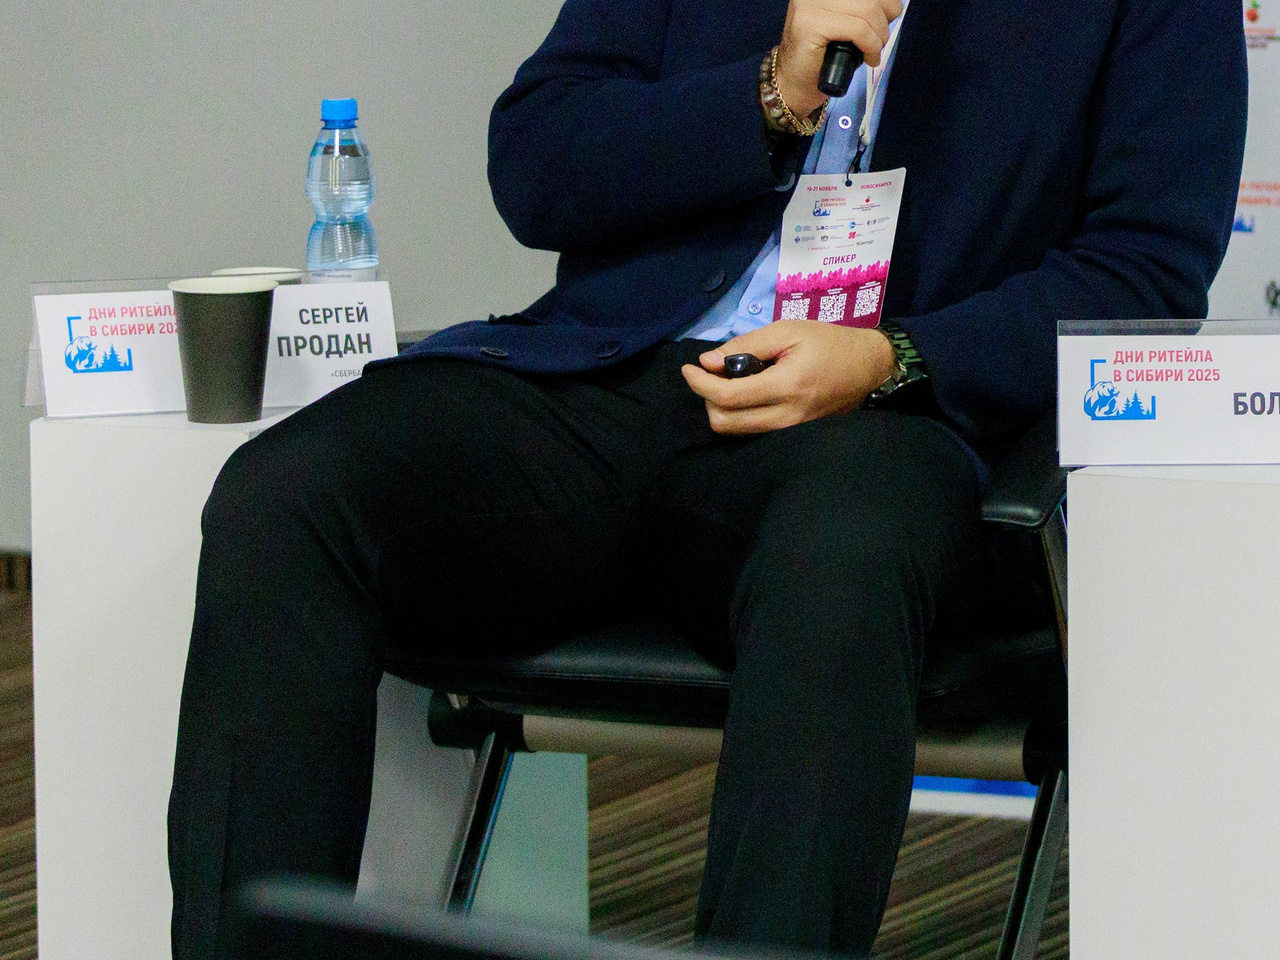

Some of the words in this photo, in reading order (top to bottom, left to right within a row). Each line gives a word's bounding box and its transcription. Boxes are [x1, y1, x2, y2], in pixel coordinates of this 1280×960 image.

[822, 253, 857, 266] СПИКЕР
[88, 307, 116, 320] ДНИ
[299, 302, 368, 325] СЕРГЕЙ
[90, 326, 97, 337] В
[102, 323, 155, 336] СИБИРИ
[277, 333, 372, 358] ПРОДАН
[1113, 351, 1143, 364] ДНИ
[1149, 347, 1213, 362] РИТЕЙЛА
[1113, 369, 1121, 382] В
[1126, 369, 1183, 382] СИБИРИ
[1188, 369, 1220, 381] 2025
